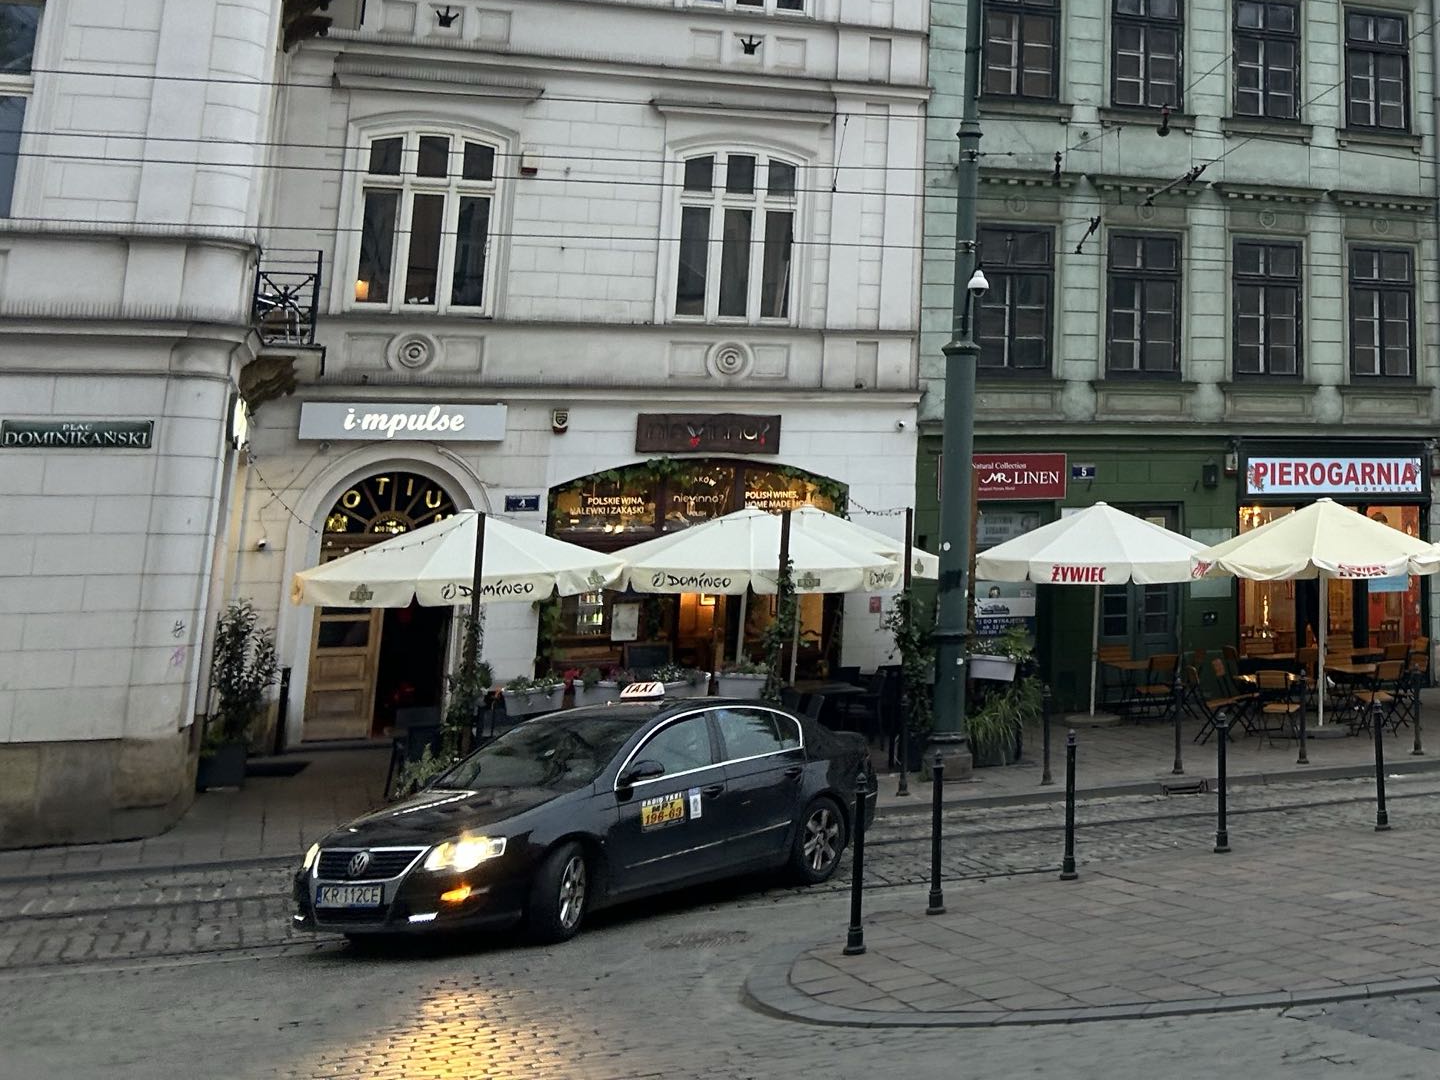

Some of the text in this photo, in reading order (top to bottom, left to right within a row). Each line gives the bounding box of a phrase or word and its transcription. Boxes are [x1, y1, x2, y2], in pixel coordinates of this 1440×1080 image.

[62, 423, 93, 431] PLAC
[5, 430, 148, 446] DOMINIKAŃSKI
[994, 461, 1027, 470] Collection
[1014, 471, 1060, 485] LINEN
[1081, 467, 1087, 477] 5
[1253, 462, 1417, 486] PIEROGARNIA
[587, 496, 645, 506] POLSKIE WINA,
[745, 491, 772, 499] POLISH
[769, 500, 791, 508] MADE
[1051, 564, 1107, 582] ŻYWIEC
[625, 682, 657, 694] TAXI
[652, 801, 675, 813] MPT
[645, 807, 682, 825] 196-63
